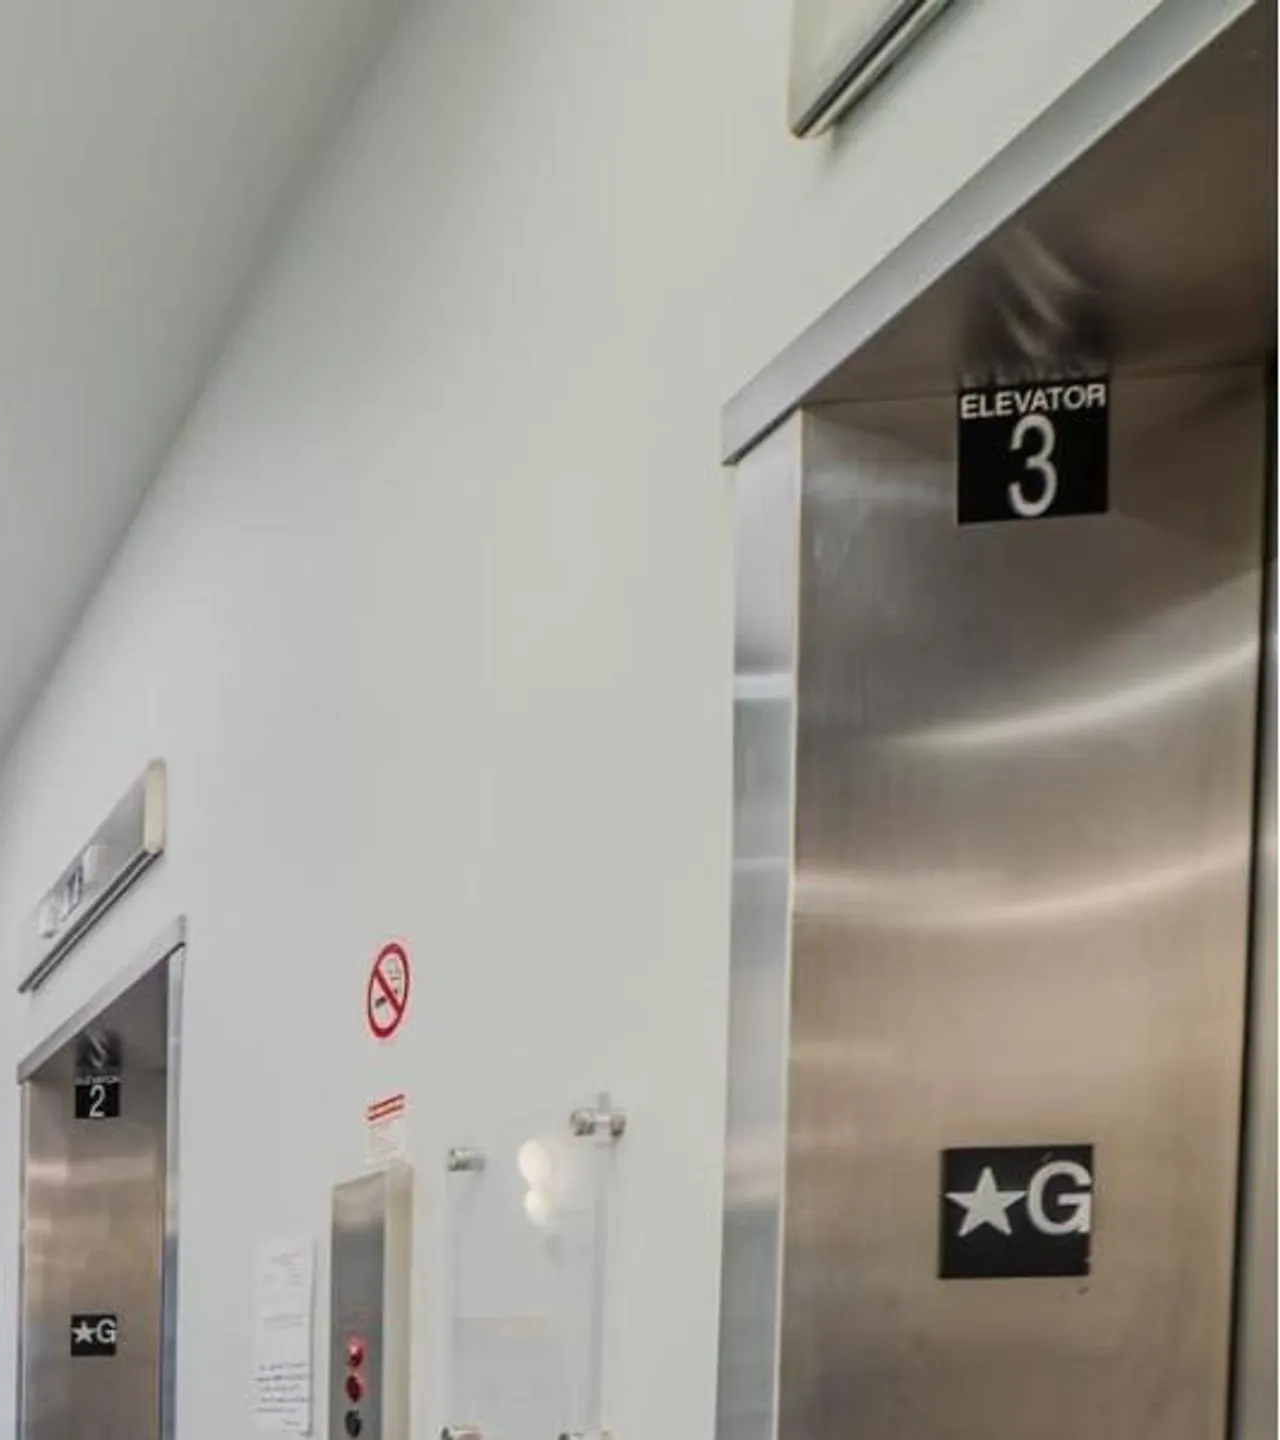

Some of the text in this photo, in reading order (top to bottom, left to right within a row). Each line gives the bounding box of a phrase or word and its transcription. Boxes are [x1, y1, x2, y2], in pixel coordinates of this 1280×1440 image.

[960, 383, 1106, 419] ELEVATOR
[1007, 414, 1058, 517] 3
[89, 1084, 106, 1118] 2
